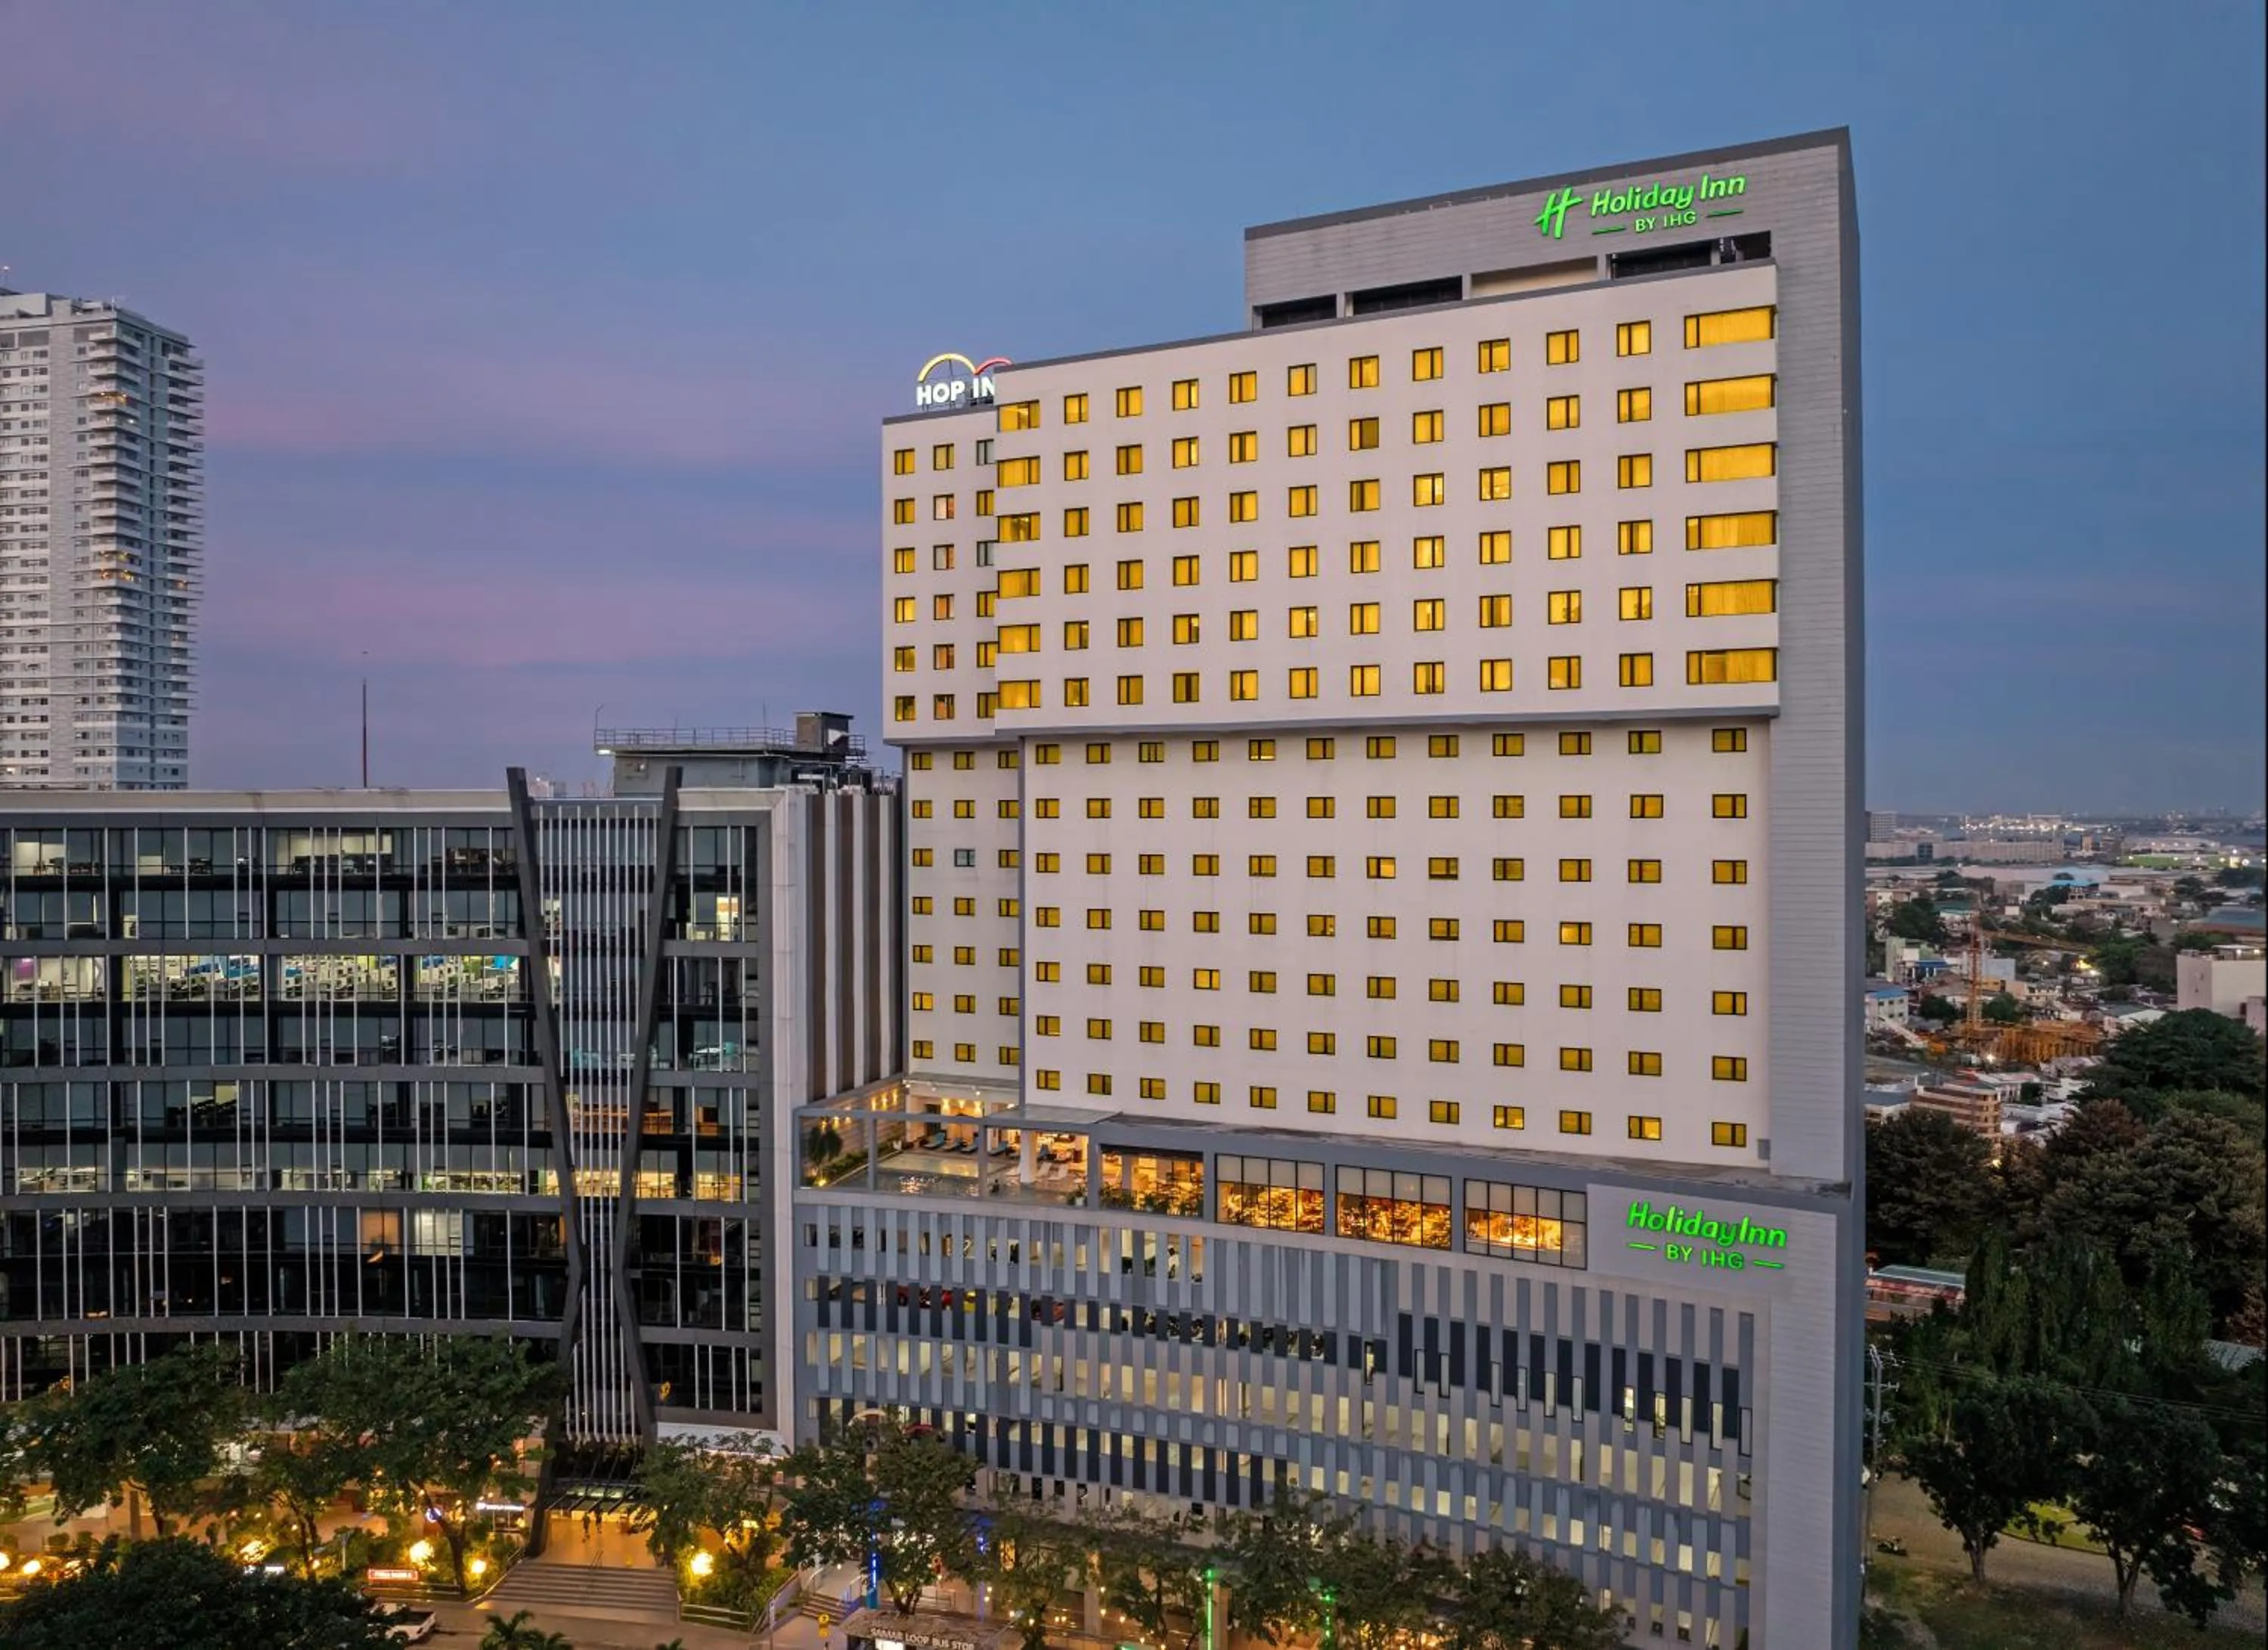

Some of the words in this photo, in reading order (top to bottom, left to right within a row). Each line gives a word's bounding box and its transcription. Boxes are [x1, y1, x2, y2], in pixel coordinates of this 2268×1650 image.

[1591, 181, 1694, 217] Holiday
[1700, 174, 1746, 200] Inn
[1634, 216, 1656, 233] BY
[1663, 210, 1696, 228] IHG
[917, 380, 965, 406] HOP
[972, 377, 996, 398] IN
[1627, 1201, 1737, 1247] Holiday
[1739, 1216, 1788, 1248] Inn
[1666, 1244, 1693, 1262] BY
[1702, 1249, 1745, 1270] IHG
[905, 1633, 930, 1645] LOOP
[932, 1637, 950, 1648] BUS
[952, 1639, 975, 1650] STOP
